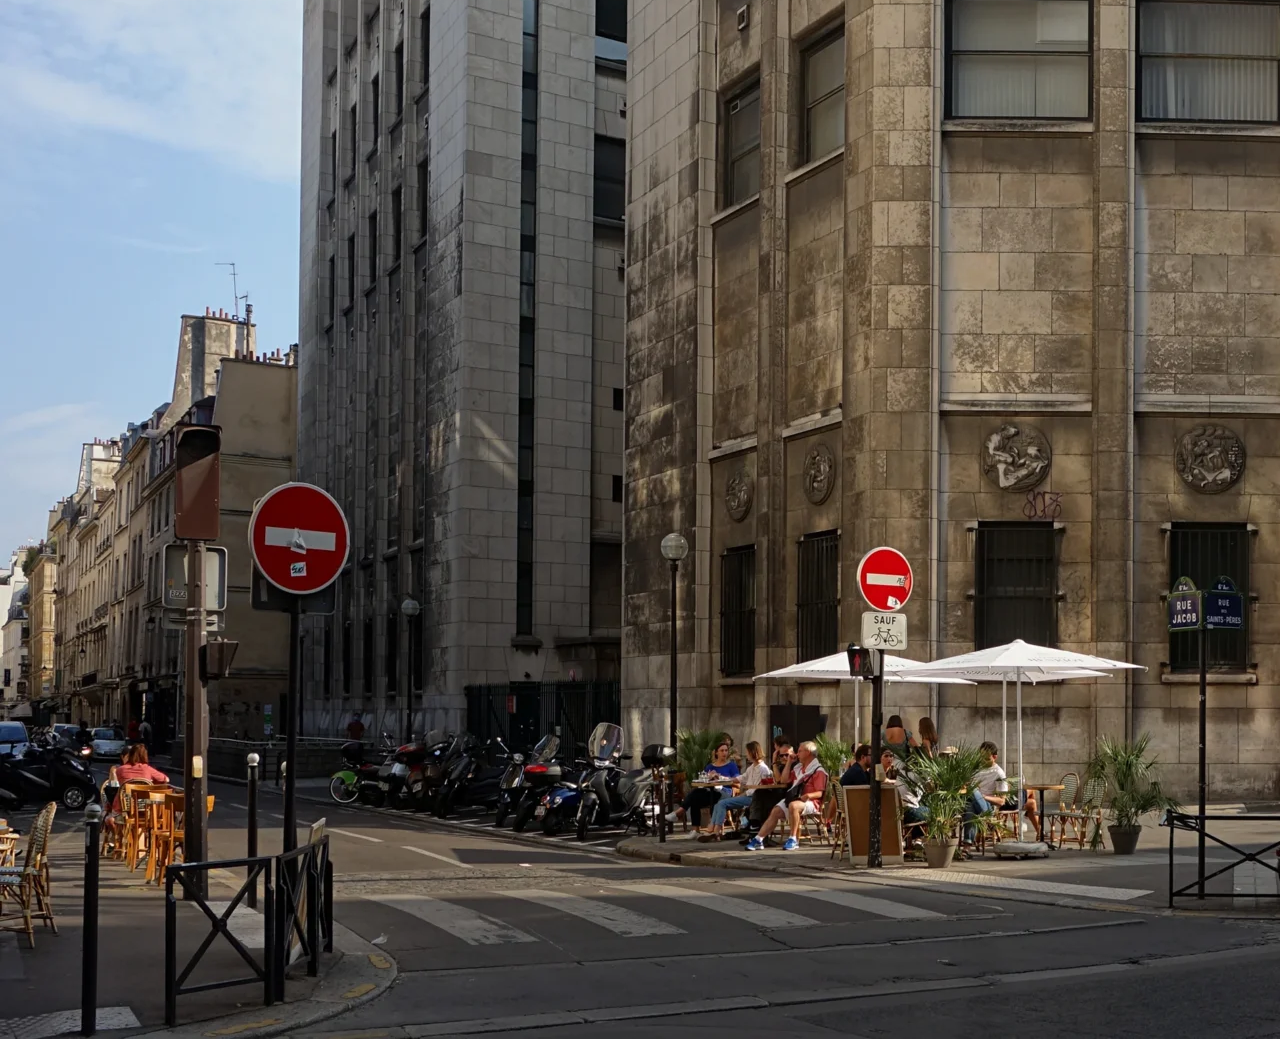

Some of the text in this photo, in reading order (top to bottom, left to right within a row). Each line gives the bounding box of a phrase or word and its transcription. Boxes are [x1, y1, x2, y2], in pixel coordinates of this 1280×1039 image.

[1176, 600, 1192, 611] RUE
[1217, 599, 1230, 607] RUE
[873, 615, 897, 625] SAUF
[1172, 612, 1197, 624] JACOB
